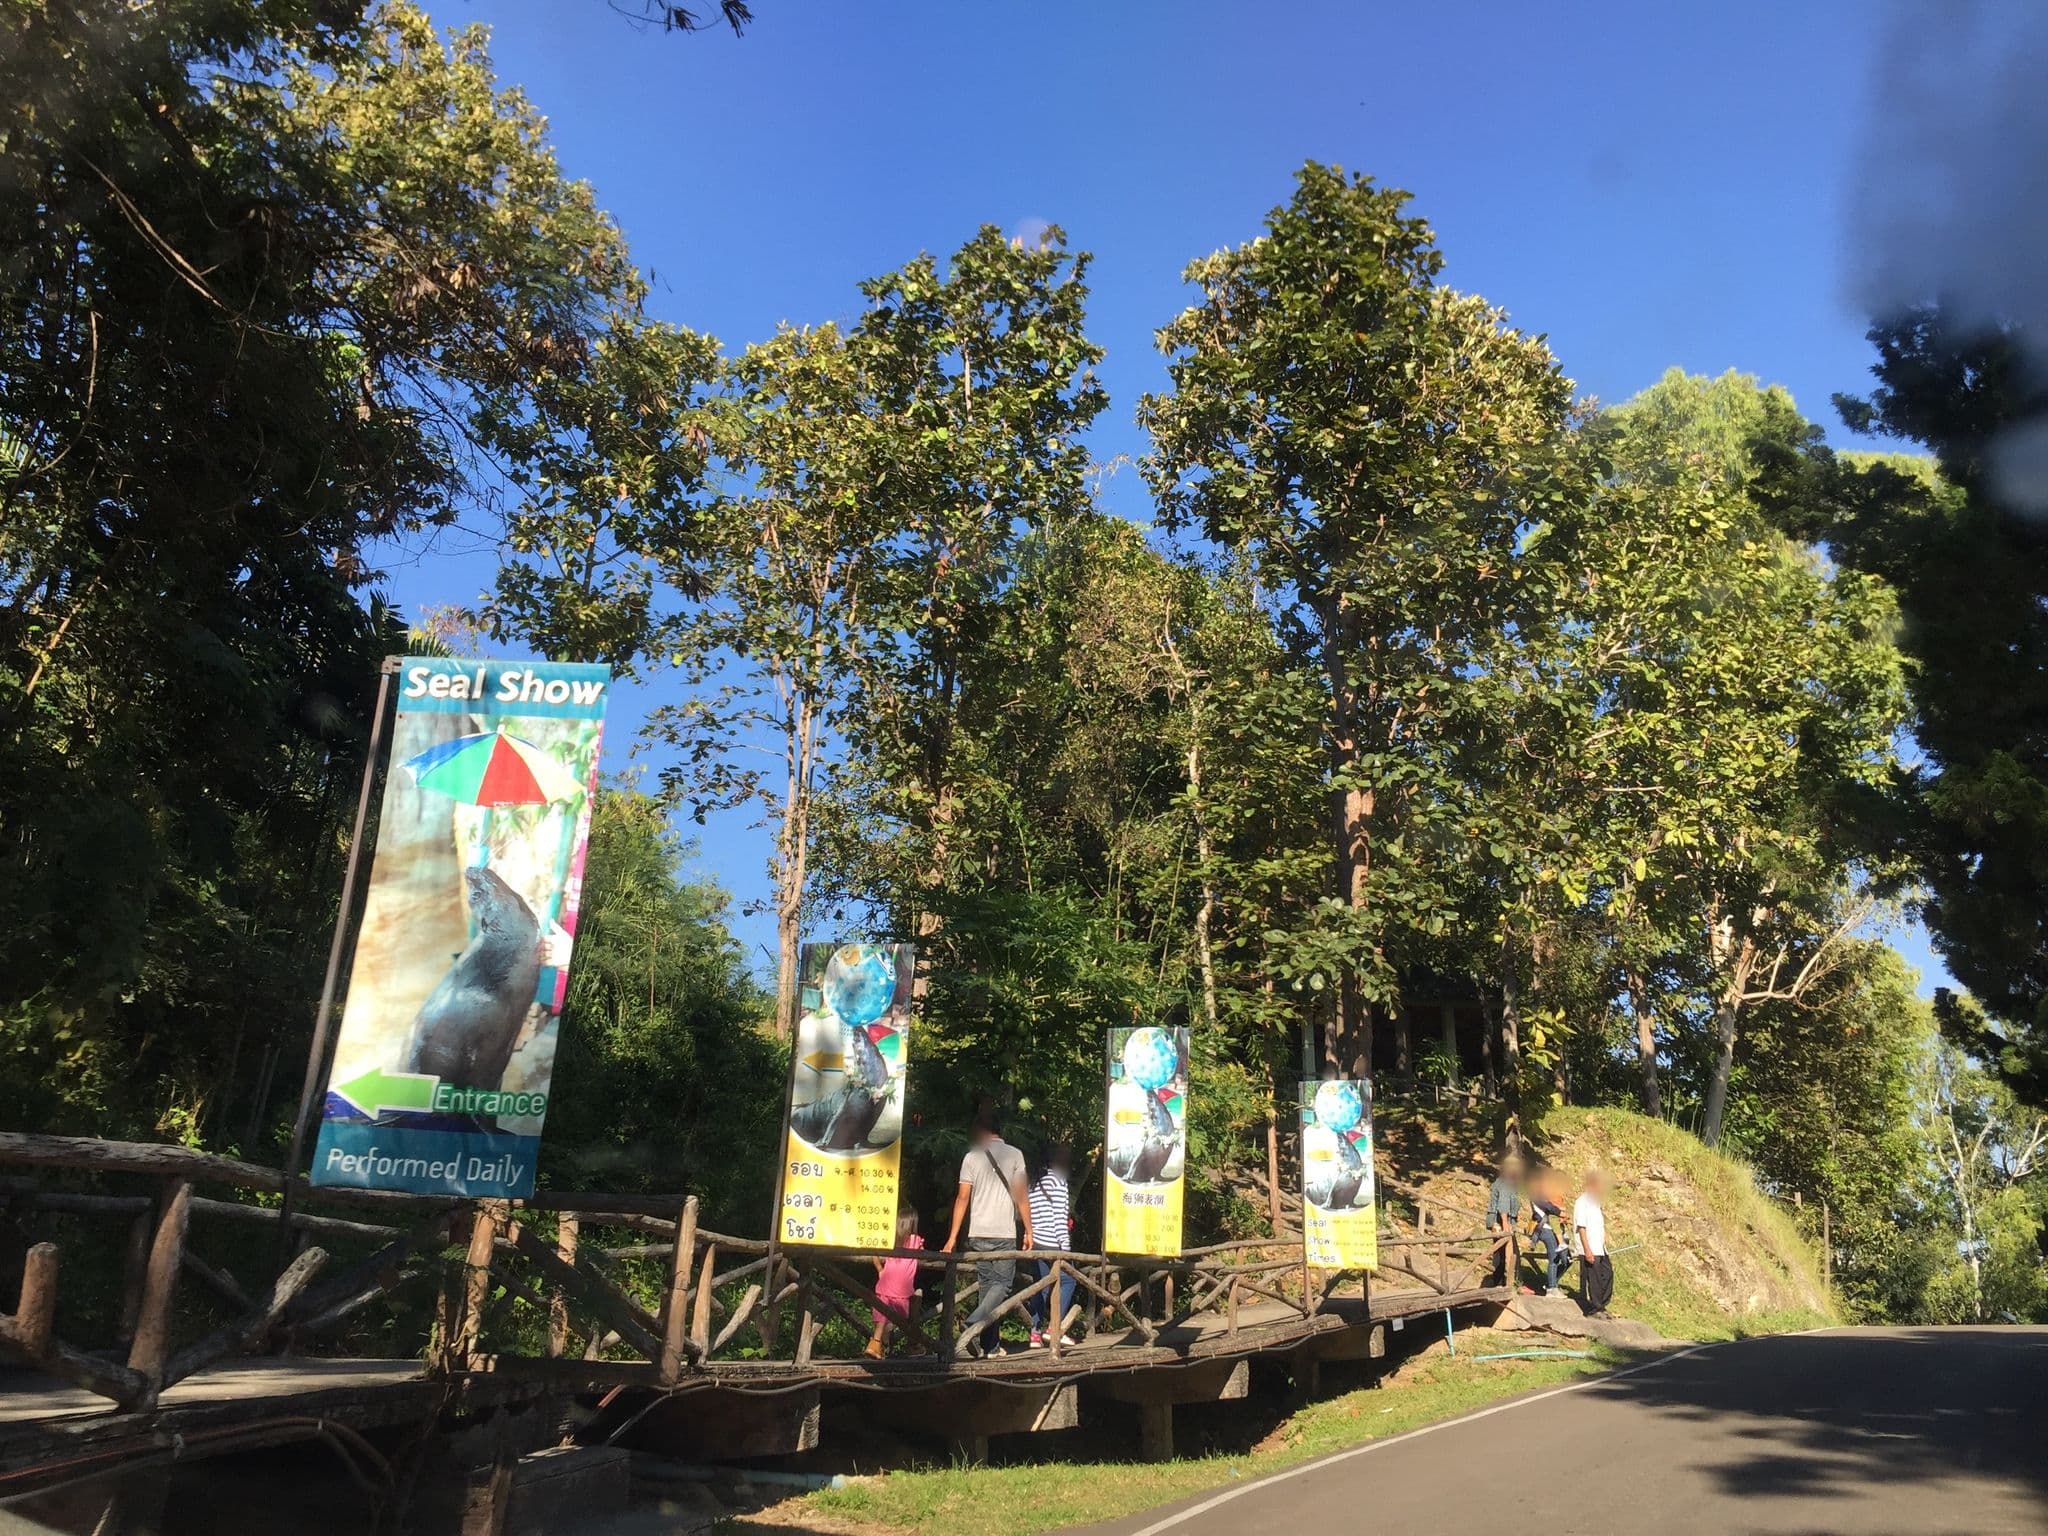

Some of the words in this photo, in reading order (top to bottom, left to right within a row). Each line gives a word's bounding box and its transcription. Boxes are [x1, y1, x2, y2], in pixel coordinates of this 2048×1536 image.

[404, 666, 486, 701] Seal
[496, 669, 604, 705] Show
[434, 1084, 545, 1114] Entrance
[326, 1147, 461, 1181] Performed
[467, 1154, 524, 1188] Daily
[791, 1162, 823, 1176] รอบ
[786, 1194, 822, 1207] เวลา
[857, 1205, 881, 1215] 10.30
[786, 1216, 816, 1238] โชว์
[1307, 1219, 1327, 1228] Seal
[1308, 1252, 1336, 1263] Times
